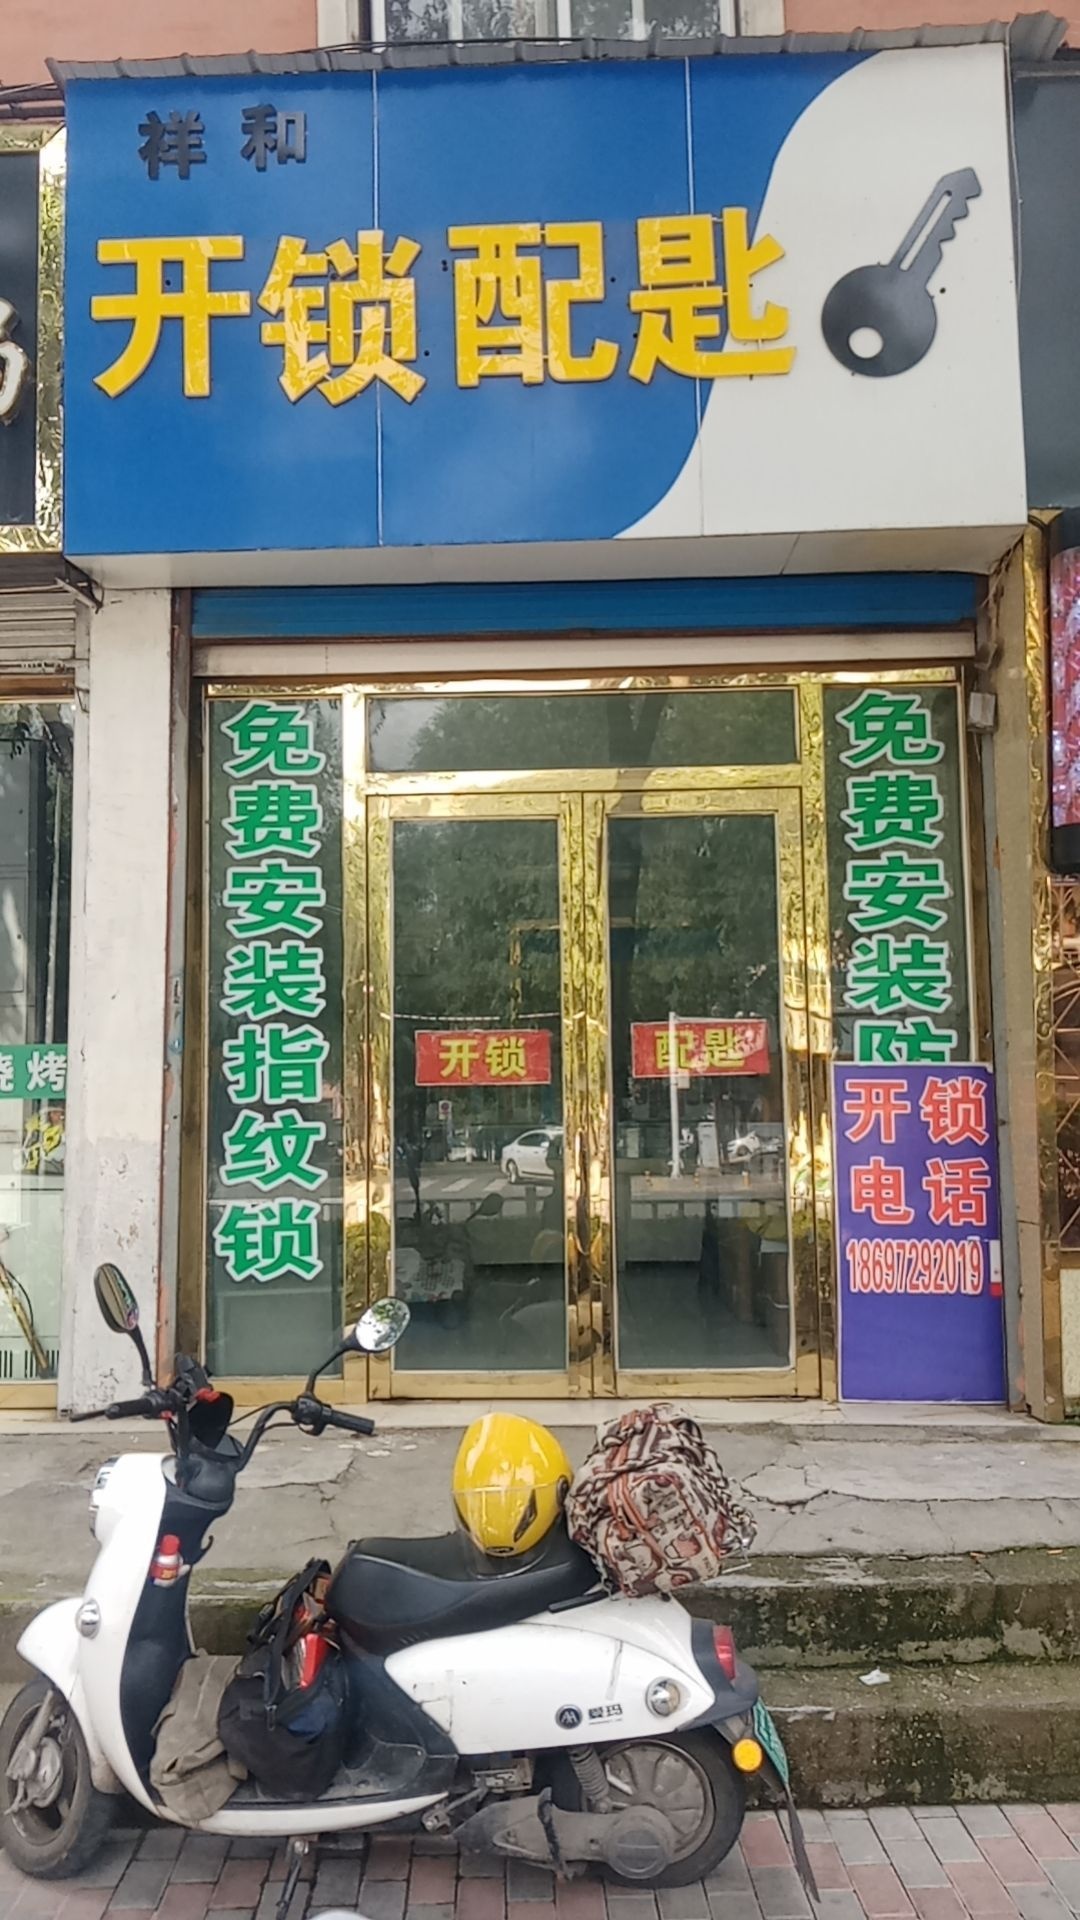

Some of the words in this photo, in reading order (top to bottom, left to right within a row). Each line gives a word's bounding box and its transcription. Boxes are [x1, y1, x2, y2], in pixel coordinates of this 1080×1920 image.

[138, 104, 307, 179] 祥和
[90, 207, 797, 406] 开锁配匙
[216, 701, 329, 1282] 免费安装指纹锁
[438, 1036, 528, 1078] 开锁
[654, 1026, 747, 1070] 配匙
[845, 1076, 989, 1145] 开锁
[849, 1158, 991, 1227] 电话
[846, 1237, 984, 1295] 18697292019
